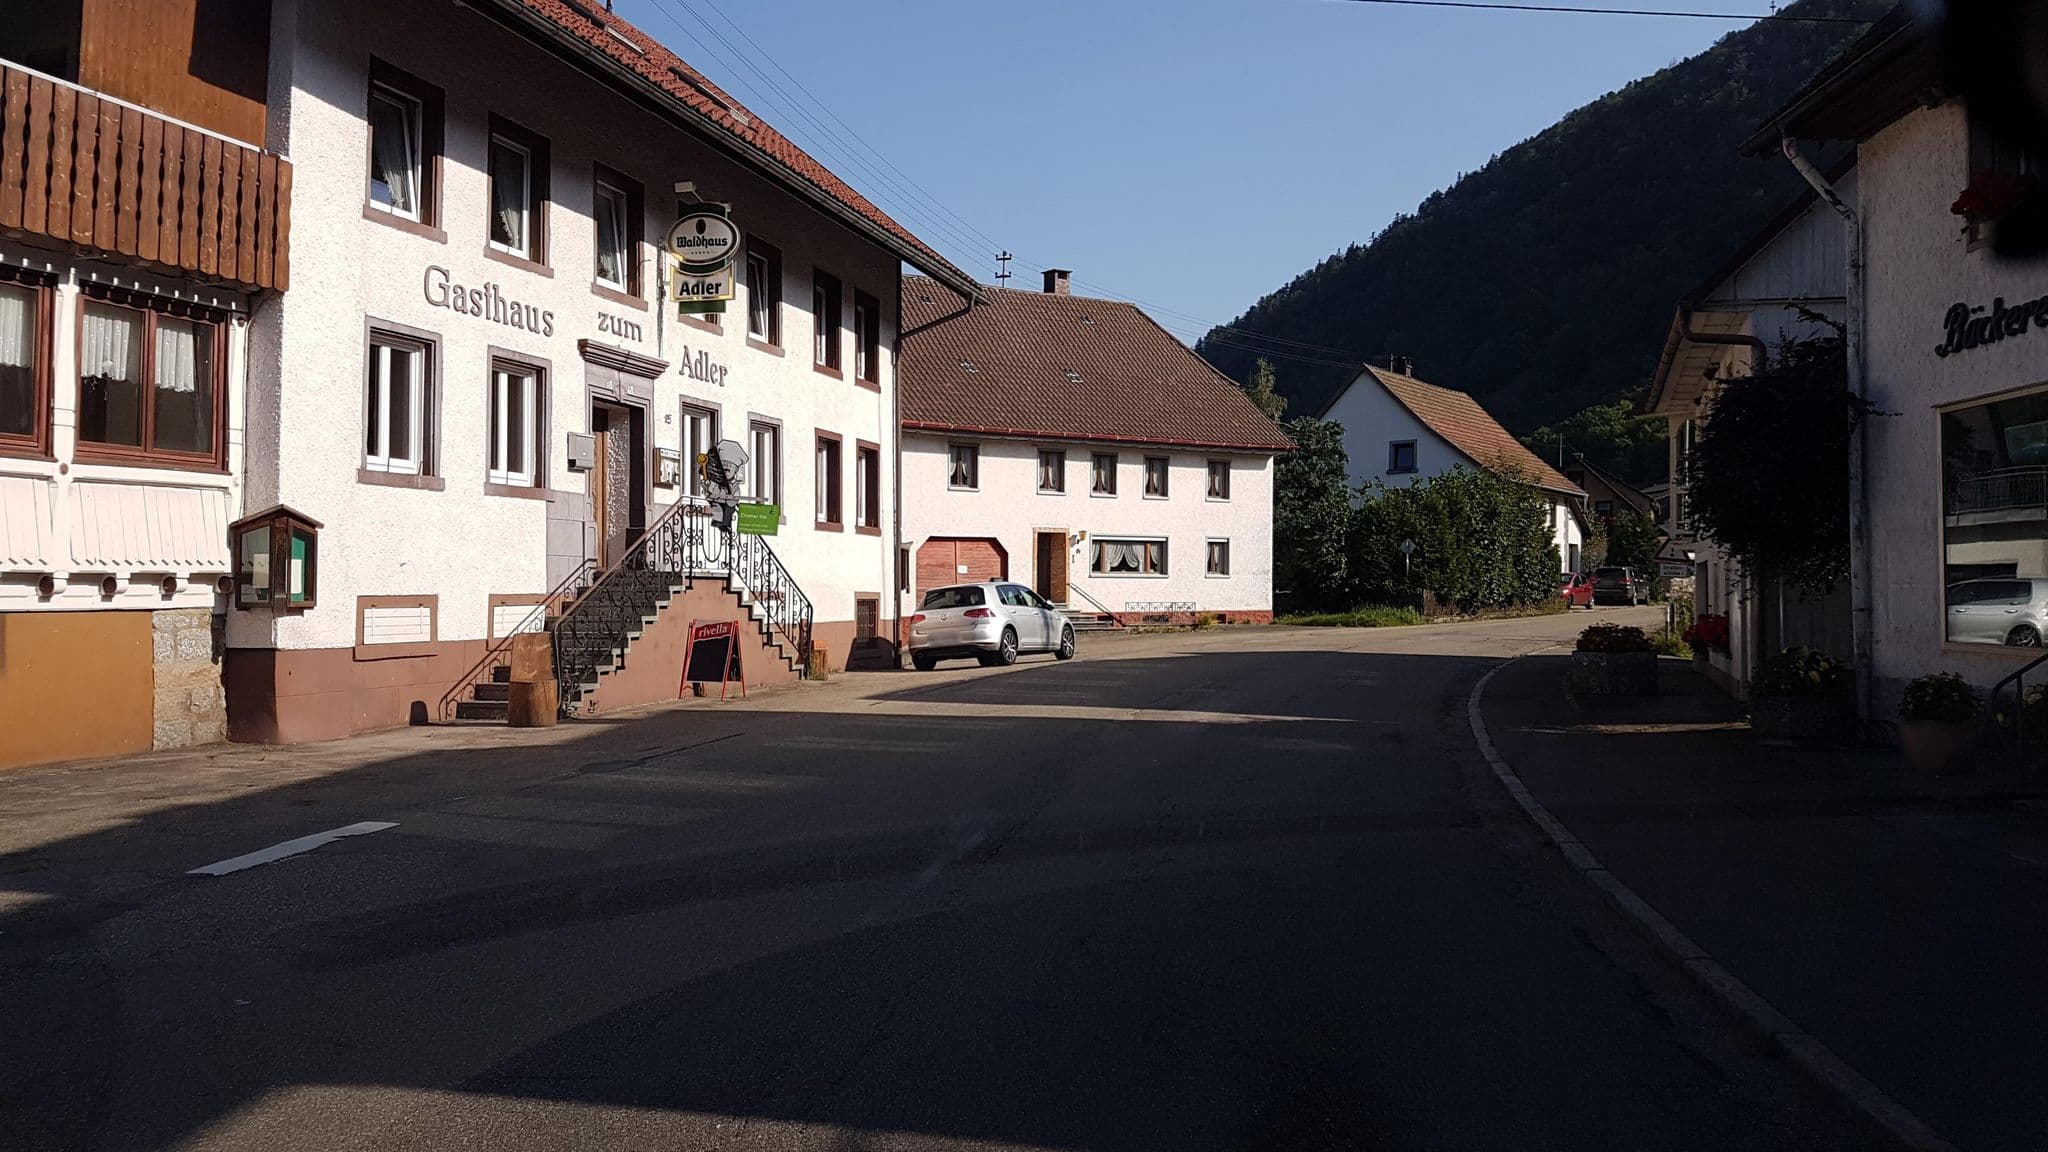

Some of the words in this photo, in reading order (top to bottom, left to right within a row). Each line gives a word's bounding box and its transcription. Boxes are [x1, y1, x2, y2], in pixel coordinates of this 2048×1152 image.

[676, 235, 728, 249] Waldhaus
[679, 280, 722, 296] Adler
[424, 265, 554, 338] Gasthaus
[598, 311, 643, 342] zum
[678, 344, 727, 386] Adler
[698, 623, 728, 638] rivella
